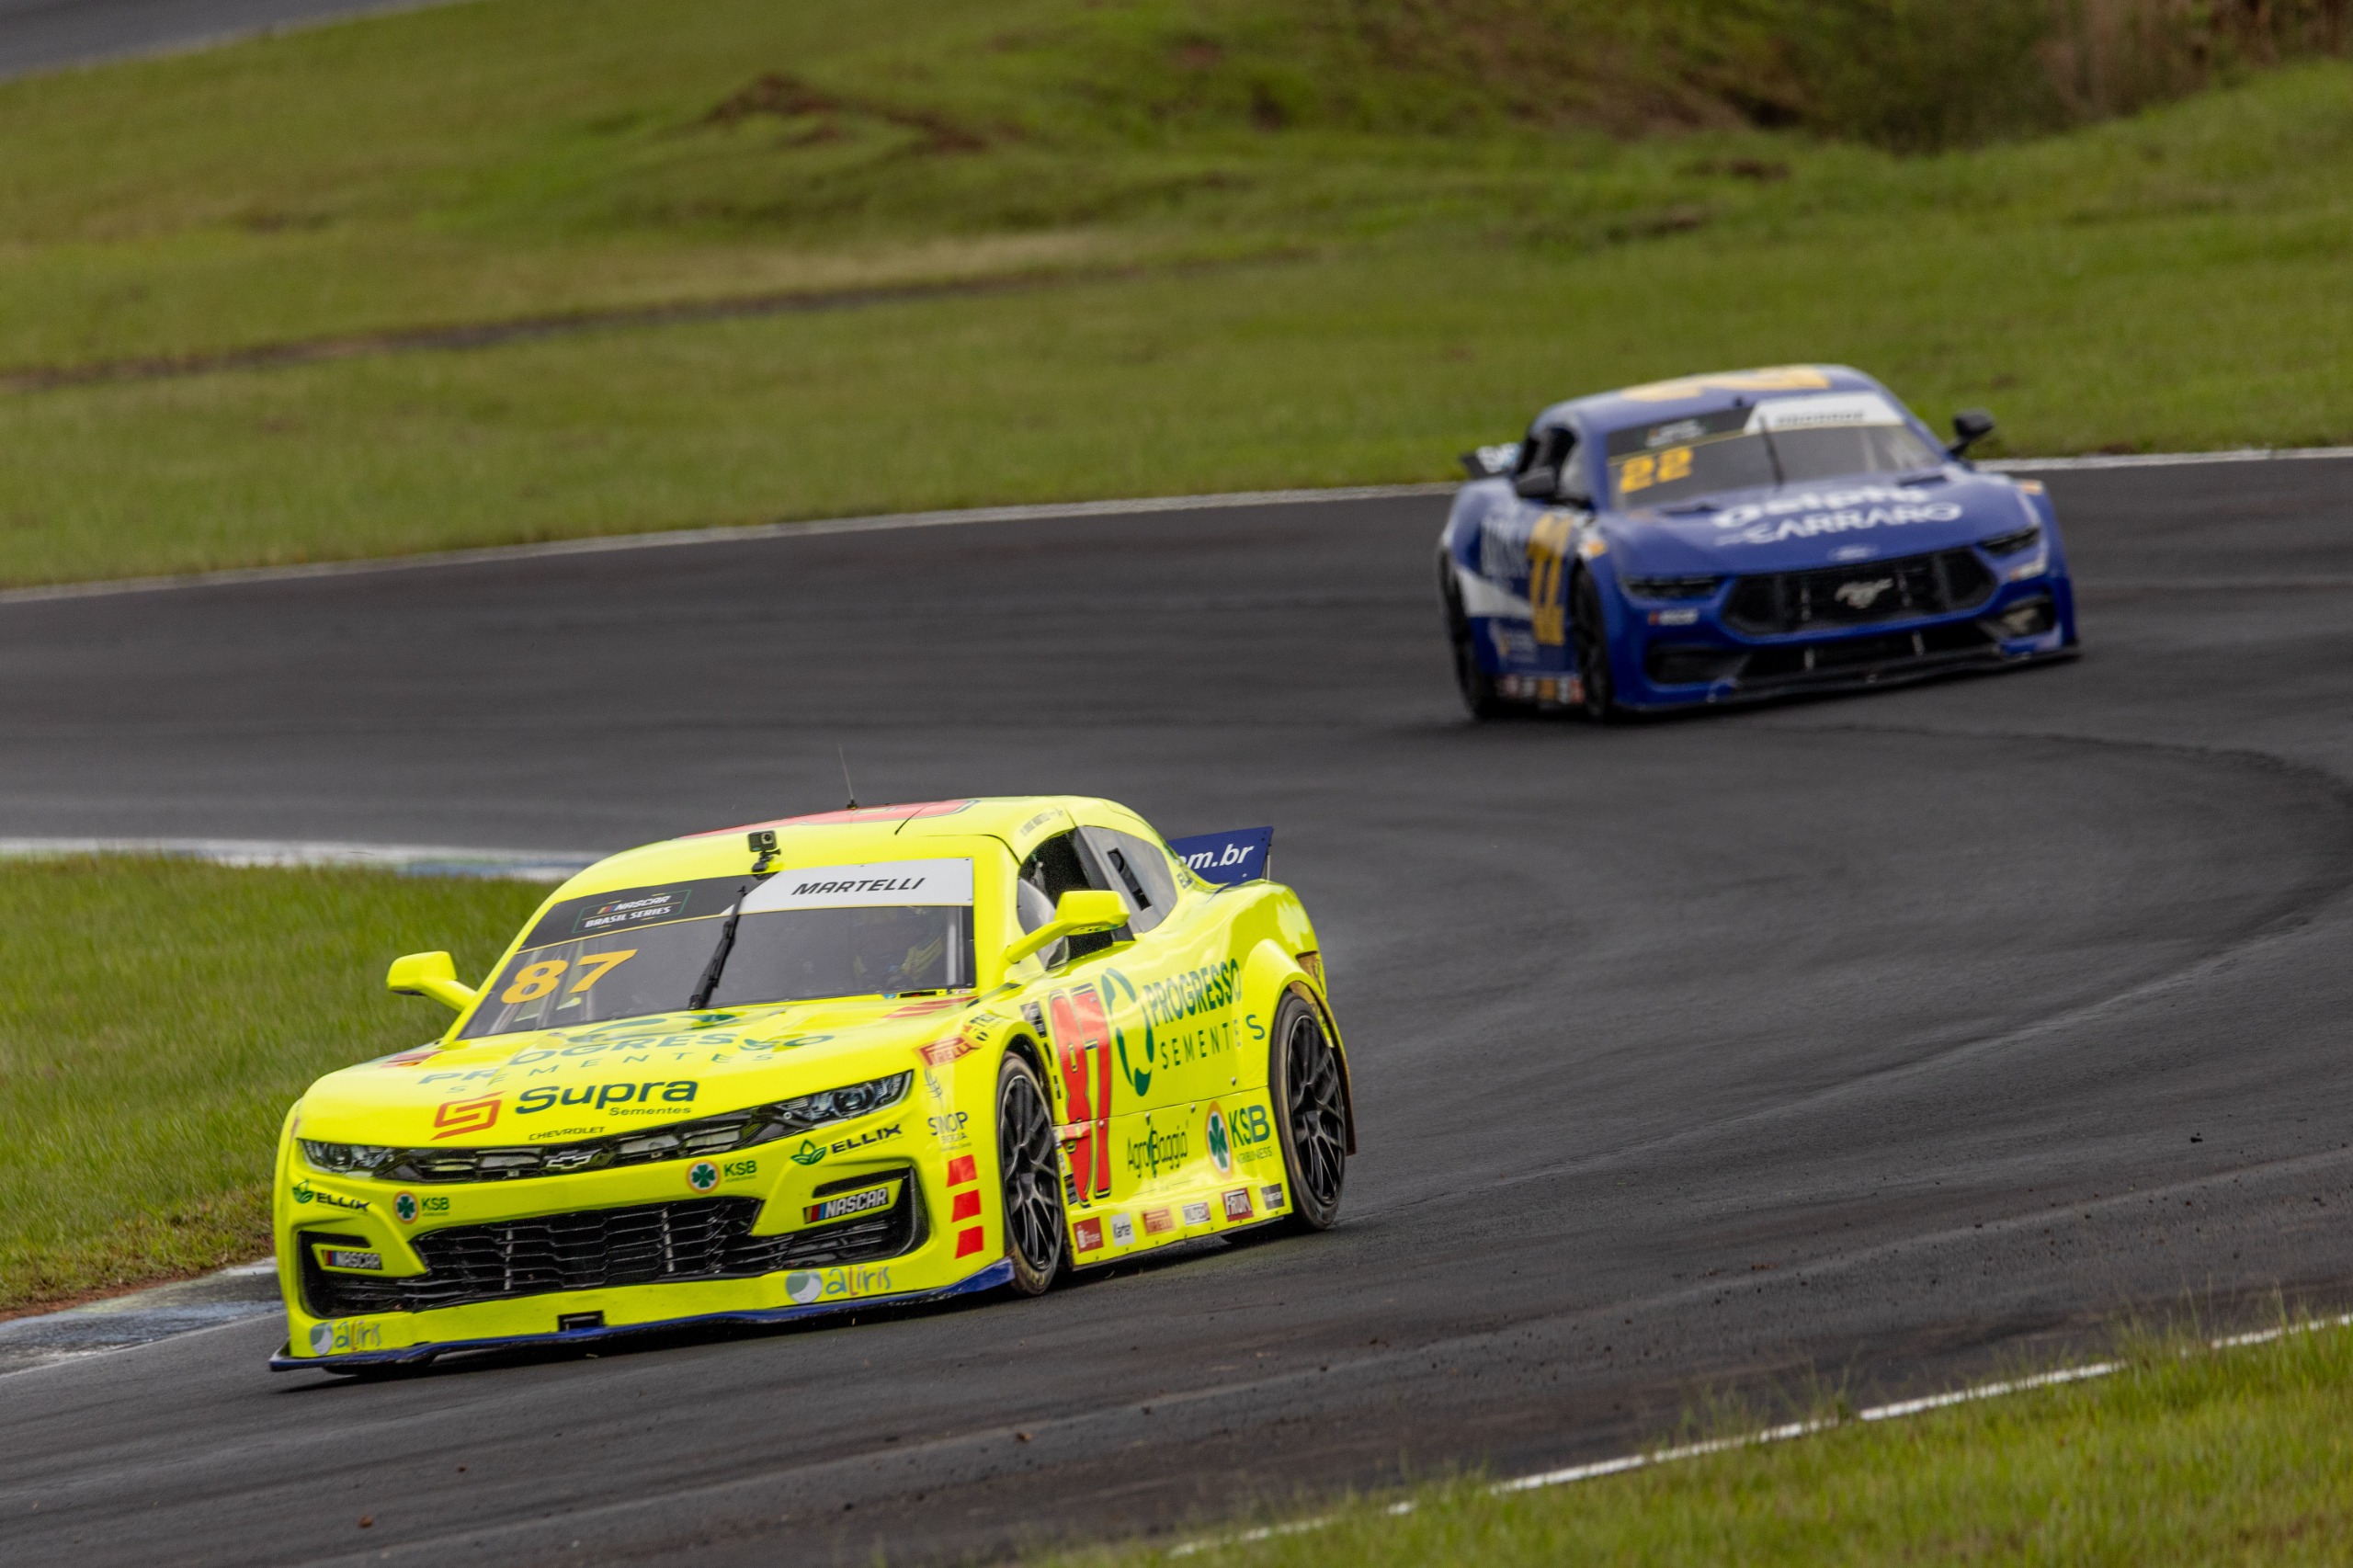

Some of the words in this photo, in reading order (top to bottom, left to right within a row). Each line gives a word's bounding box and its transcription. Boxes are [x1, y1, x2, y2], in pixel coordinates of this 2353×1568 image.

[1620, 446, 1694, 494] 22
[791, 878, 926, 895] MARTELLI
[584, 912, 631, 928] BRASIL
[630, 905, 672, 919] SERIES
[615, 895, 672, 911] NASCAR
[501, 949, 639, 1005] 87
[1142, 958, 1243, 1027] PROGRESSO
[1160, 1014, 1266, 1070] SEMENTES
[417, 1032, 835, 1085] PROGRESSO
[515, 1080, 699, 1115] Supra
[1049, 982, 1112, 1209] 87
[608, 1106, 692, 1117] Sementes
[1228, 1105, 1271, 1149] KSB
[529, 1126, 606, 1141] CHEVROLET
[831, 1123, 903, 1154] ELLIX
[724, 1160, 758, 1177] KSB
[316, 1192, 371, 1211] ELLIX
[421, 1197, 450, 1211] KSB
[824, 1187, 889, 1219] NASCAR
